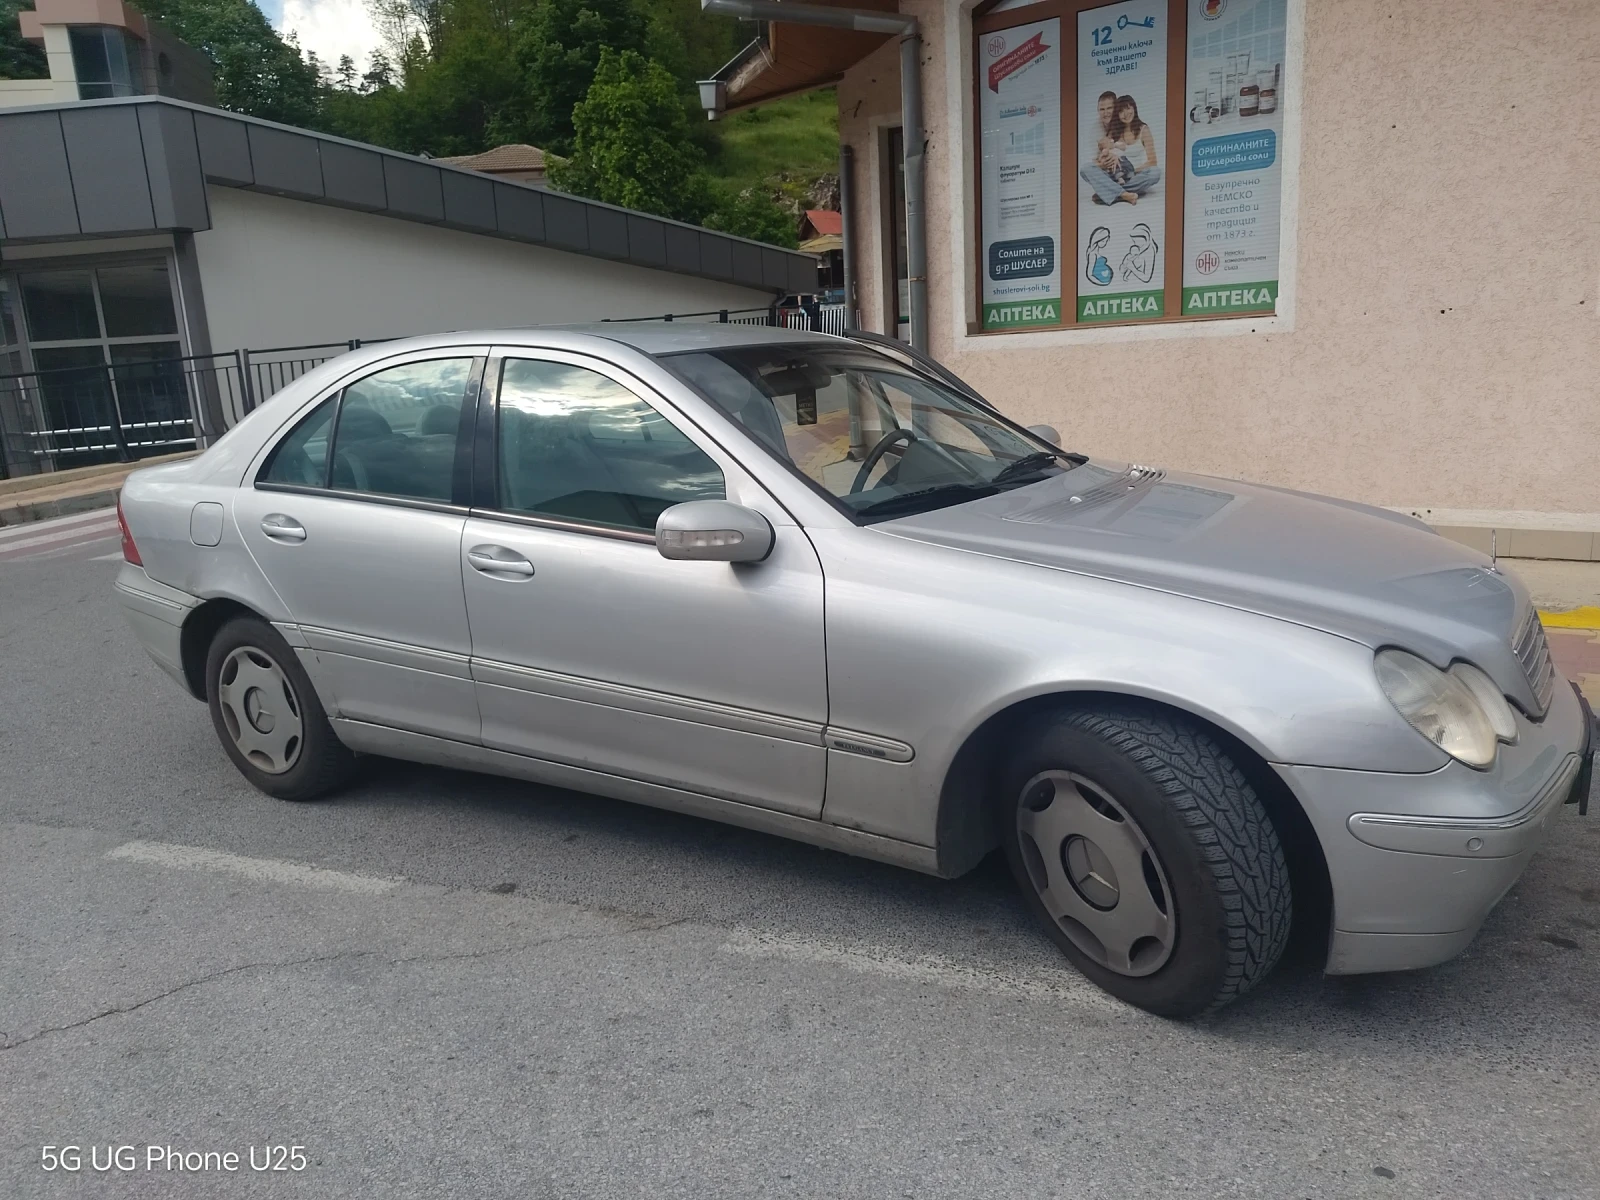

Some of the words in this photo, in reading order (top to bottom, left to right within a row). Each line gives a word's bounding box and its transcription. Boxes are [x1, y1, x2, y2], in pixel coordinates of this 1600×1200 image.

[1091, 26, 1113, 46] 12
[989, 38, 1004, 55] DHU
[1091, 45, 1127, 58] безценни
[1128, 40, 1153, 51] ключа
[1096, 58, 1113, 67] към
[1113, 51, 1147, 64] Вашето
[1105, 62, 1138, 75] ЗДРАВЕ!
[1197, 138, 1269, 156] ОРИГИНАЛНИТЕ
[1197, 153, 1247, 169] Шуслерови
[1248, 152, 1269, 161] соли
[1204, 178, 1261, 192] Безупречно
[1211, 190, 1253, 203] НЕМСКО
[1204, 203, 1251, 217] качество
[1253, 203, 1259, 211] и
[1206, 217, 1256, 230] традиция
[1206, 232, 1221, 241] от
[1224, 230, 1246, 240] 1873
[998, 247, 1033, 259] Солите
[1033, 246, 1045, 255] на
[995, 263, 1010, 275] д-р
[1011, 258, 1048, 271] ШУСЛЕР
[1198, 253, 1217, 272] DHU
[992, 283, 1051, 296] shuslerovi-soli.bg
[1187, 287, 1272, 309] АПТЕКА
[987, 304, 1057, 323] АПТЕКА
[1082, 296, 1159, 316] АПТЕКА
